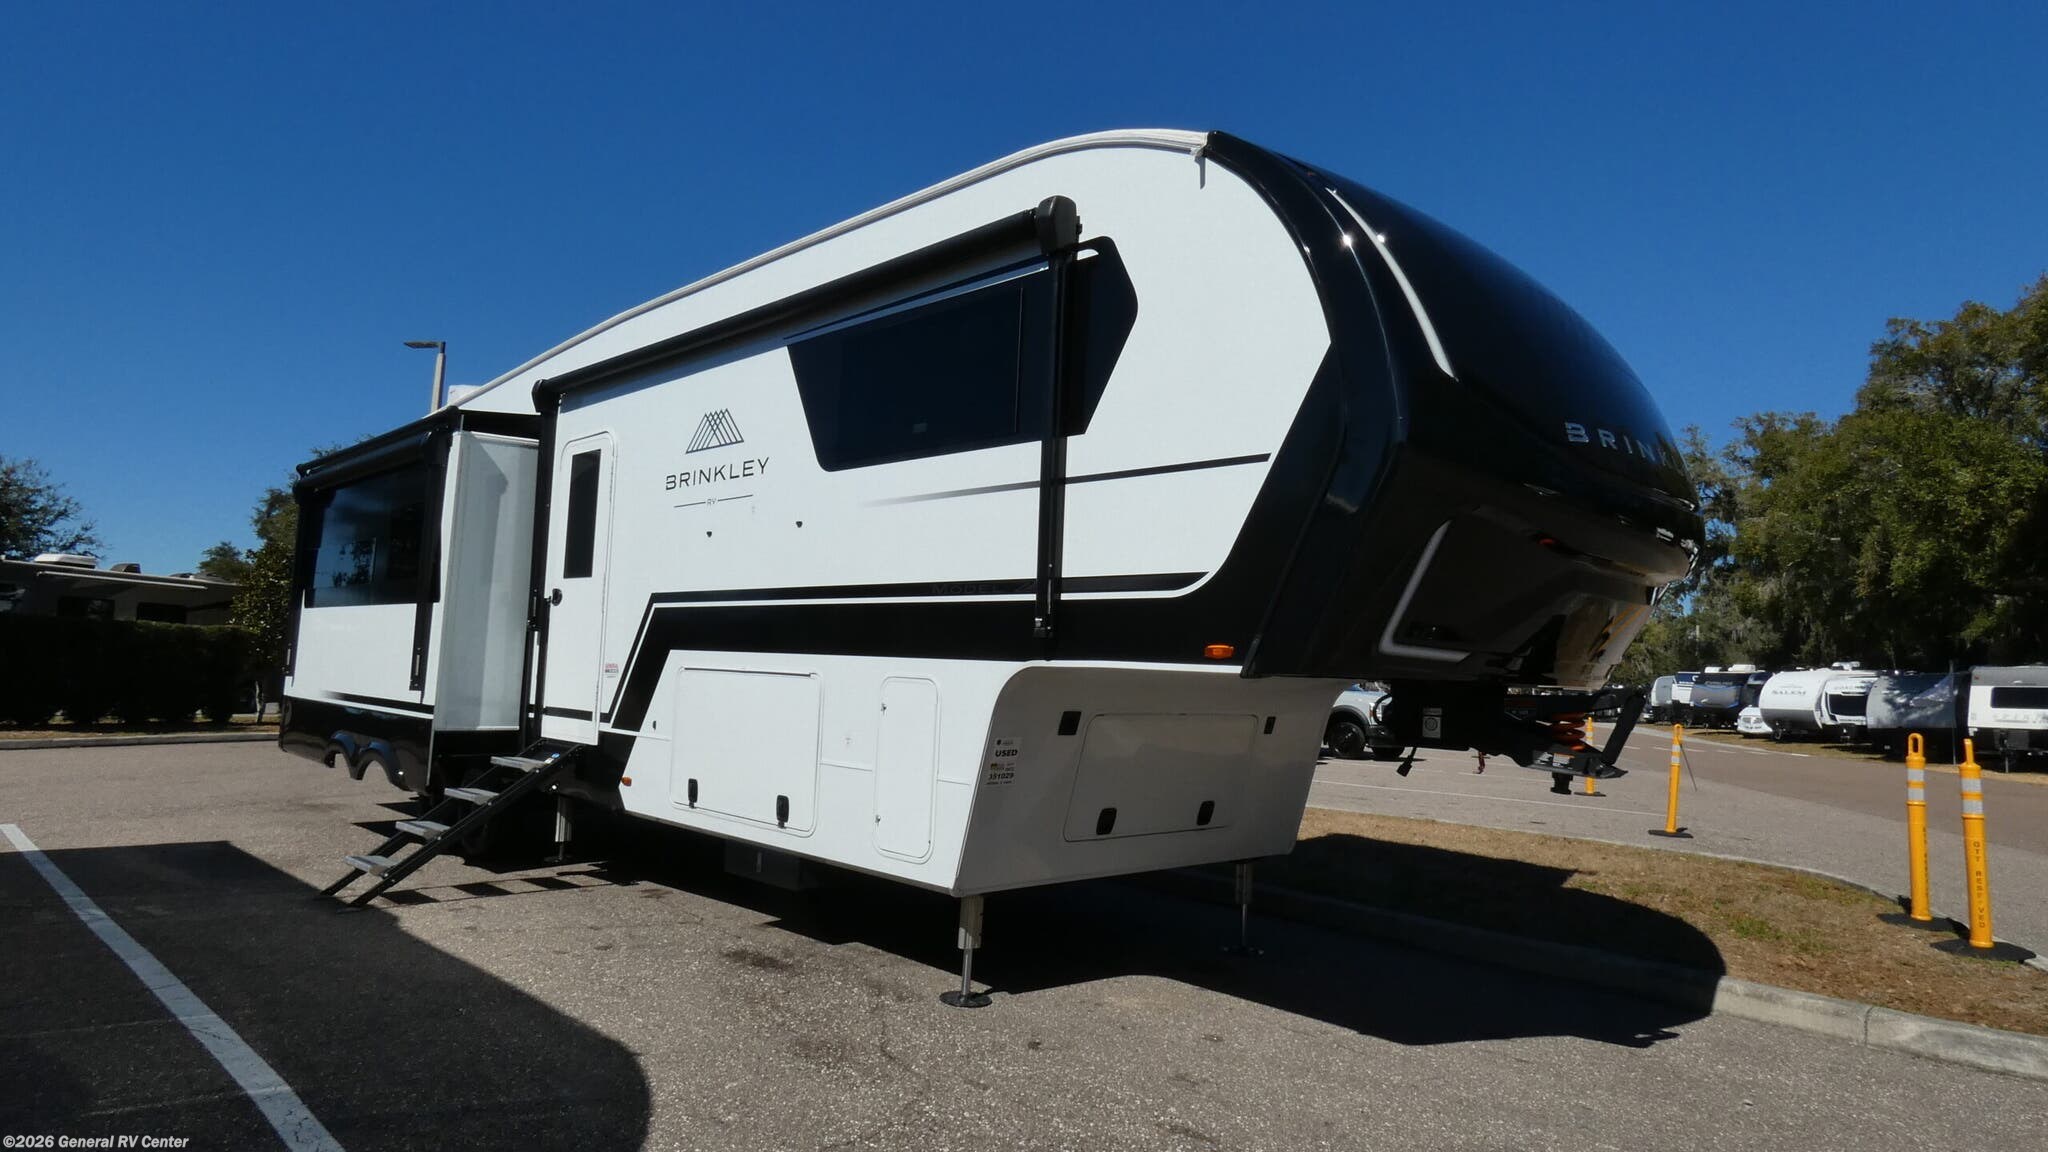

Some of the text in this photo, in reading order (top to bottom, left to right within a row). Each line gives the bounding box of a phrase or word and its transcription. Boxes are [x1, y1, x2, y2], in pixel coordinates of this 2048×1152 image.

[666, 457, 769, 491] BRINKLEY
[930, 583, 1004, 595] MODEL
[995, 749, 1018, 757] USED
